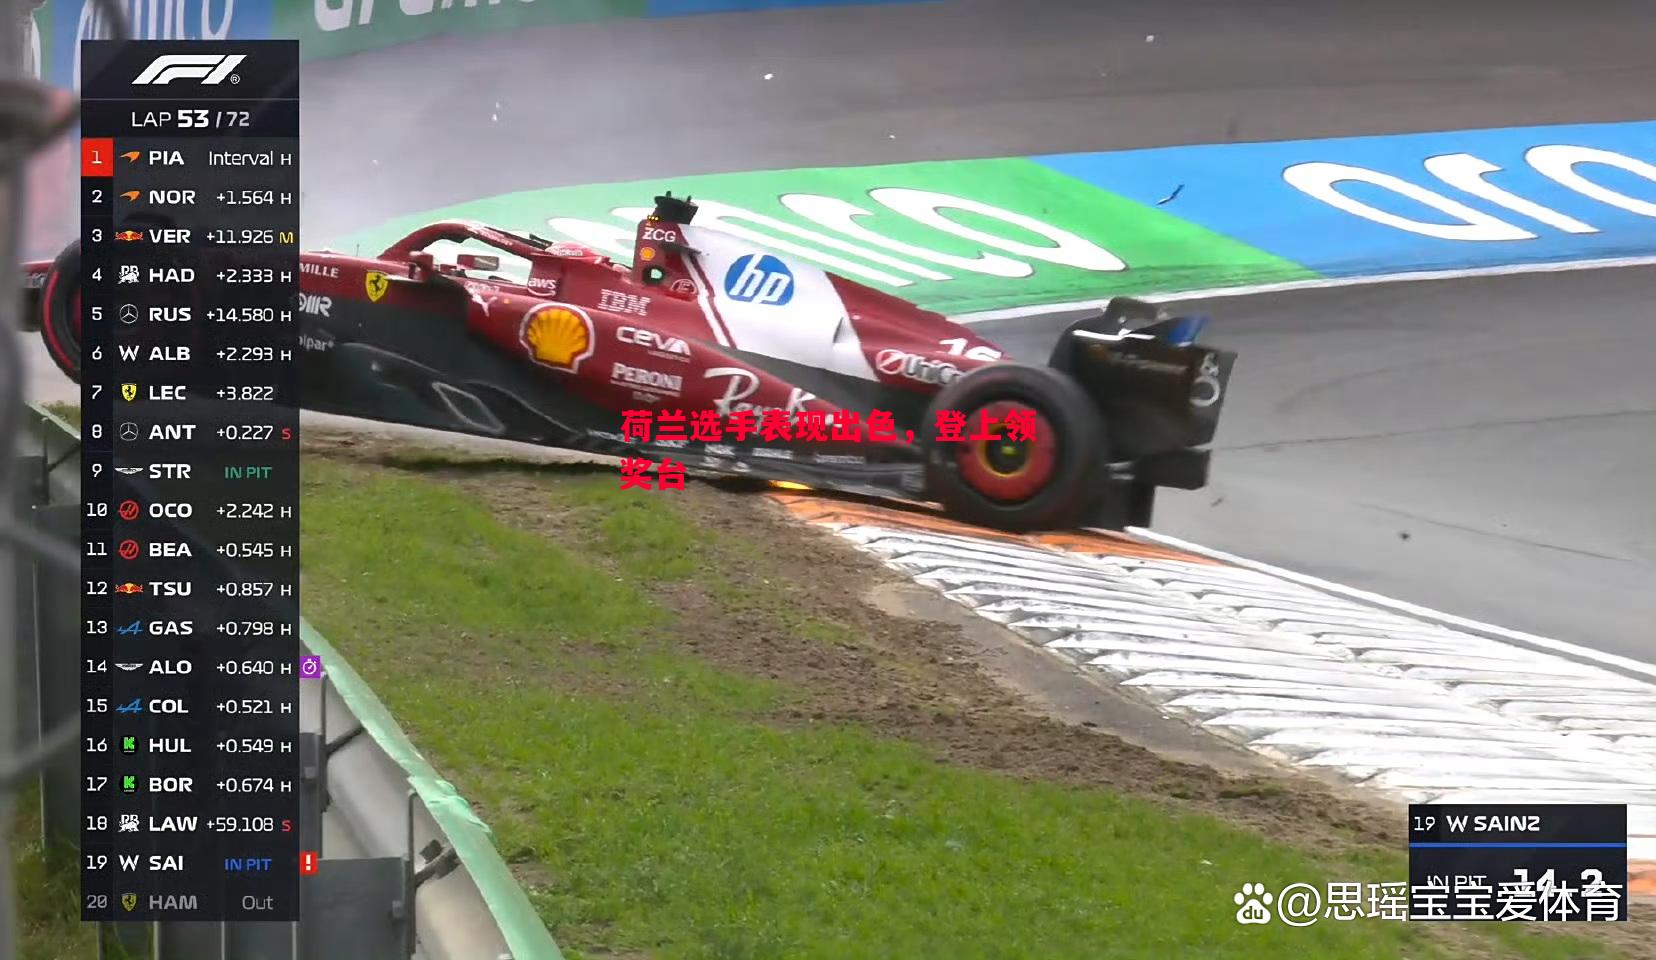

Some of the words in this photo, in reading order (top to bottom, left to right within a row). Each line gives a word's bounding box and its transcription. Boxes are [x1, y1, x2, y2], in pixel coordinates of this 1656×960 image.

[299, 263, 339, 278] MILLE
[528, 277, 557, 290] aws
[728, 253, 791, 304] hp
[597, 288, 651, 315] IBM
[616, 326, 691, 356] CEVA
[611, 362, 683, 392] PERONI
